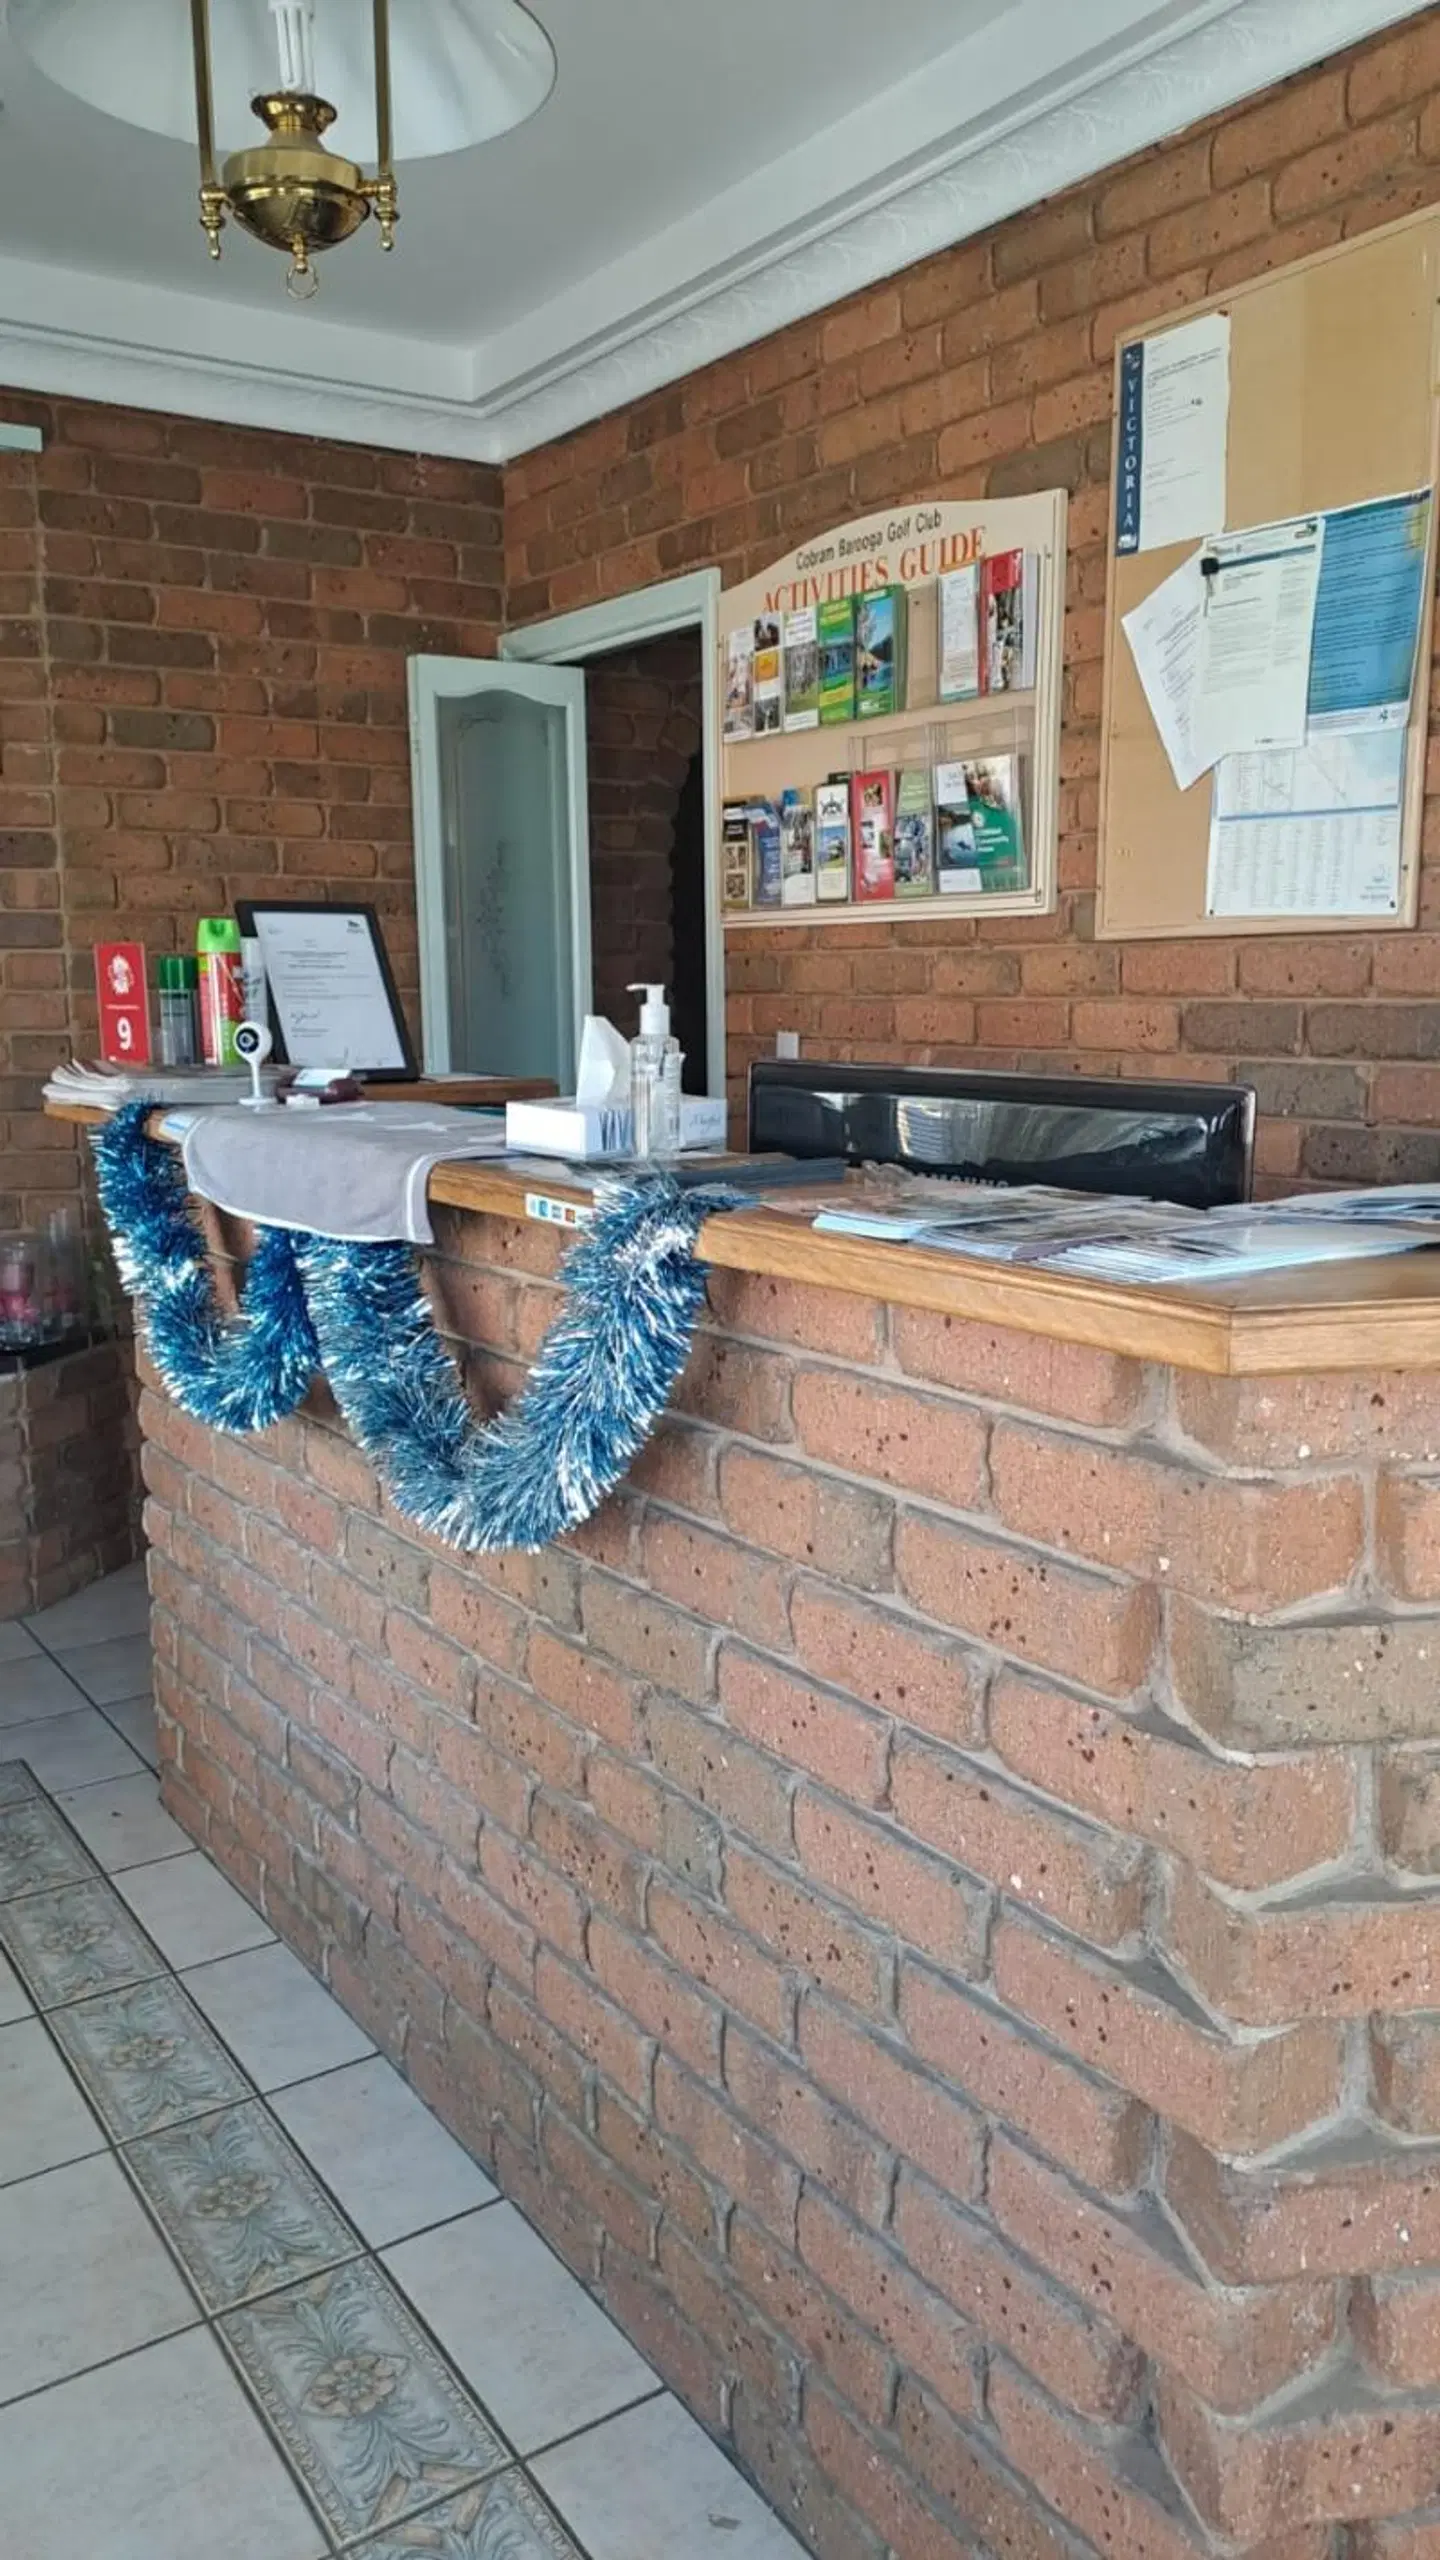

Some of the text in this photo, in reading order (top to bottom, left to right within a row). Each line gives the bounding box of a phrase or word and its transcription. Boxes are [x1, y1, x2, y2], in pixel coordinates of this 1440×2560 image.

[1124, 379, 1138, 528] VICTORIA
[764, 526, 987, 612] ACTIVITIES GUIDE
[796, 508, 942, 570] Cobram Barooga Golf Club
[117, 1017, 132, 1050] 9
